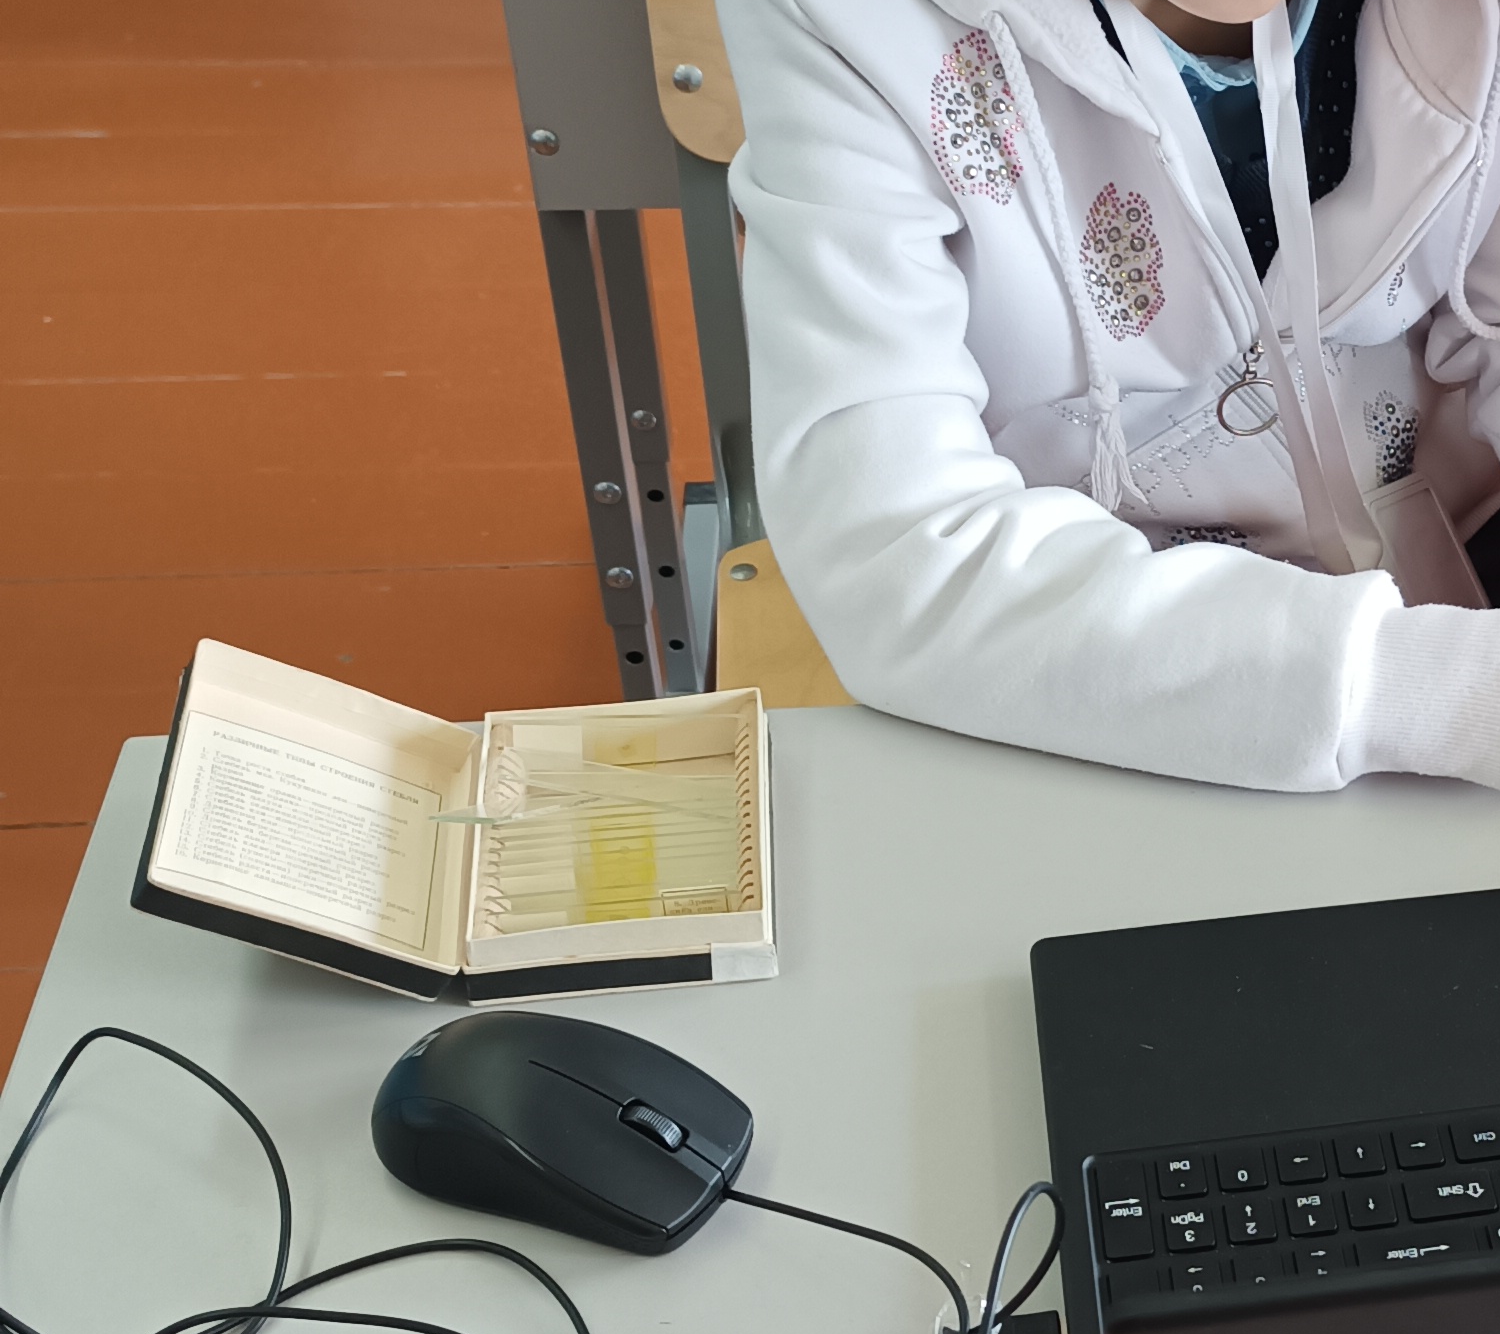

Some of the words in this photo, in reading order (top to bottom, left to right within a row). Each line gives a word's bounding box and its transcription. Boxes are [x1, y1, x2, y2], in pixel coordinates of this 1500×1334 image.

[319, 764, 375, 788] СТРОЕНИЯ
[379, 785, 419, 804] СТЕБЛЯ
[1473, 1132, 1495, 1142] Ctrl
[1170, 1160, 1190, 1170] Del
[1437, 1185, 1463, 1196] Shift
[1297, 1195, 1320, 1207] End
[1111, 1206, 1142, 1217] Enter
[1171, 1213, 1204, 1224] PgDn
[1308, 1215, 1316, 1225] 1
[1246, 1223, 1257, 1234] 2
[1184, 1230, 1195, 1241] 3
[1387, 1248, 1418, 1259] Enter
